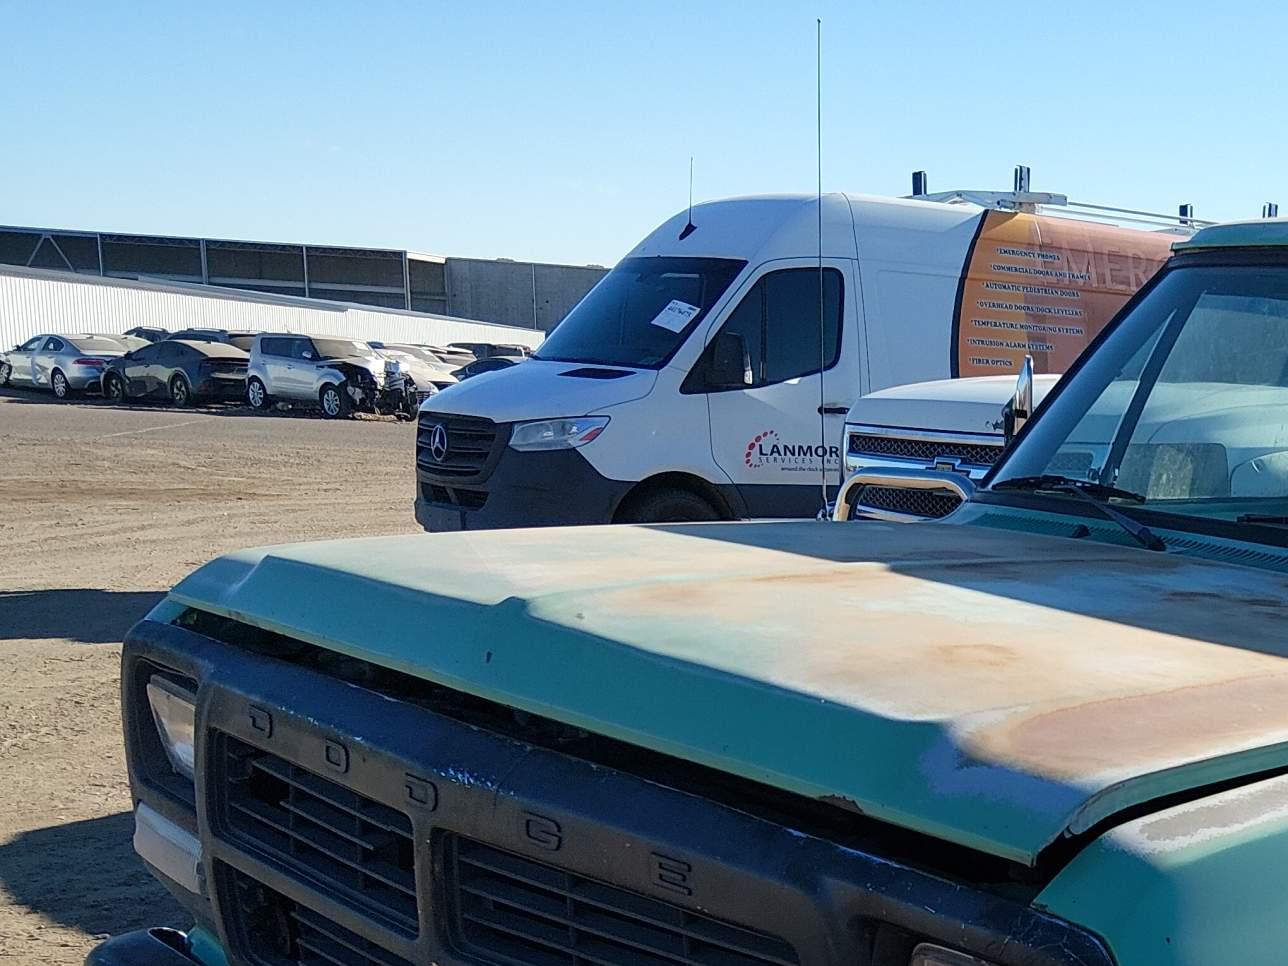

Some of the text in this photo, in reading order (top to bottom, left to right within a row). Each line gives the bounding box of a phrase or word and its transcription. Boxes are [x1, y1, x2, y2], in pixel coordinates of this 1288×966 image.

[999, 248, 1061, 260] EMERGENCY PHONES
[992, 263, 1091, 281] COMMERCIAL DOORS AND FRAMES
[985, 281, 1080, 298] AUTOMATIC PEDESTRIAN DOORS
[979, 301, 1014, 311] OVERHEAD
[973, 319, 1084, 335] TEMPERATURE MONITORING SYSTEMS
[969, 338, 1054, 351] INTRUSION ALARM SYSTEMS
[971, 358, 1013, 367] FIBER OPTICS
[758, 443, 840, 458] LANMOR
[758, 457, 814, 465] SERVICES
[246, 703, 694, 897] DODGE
